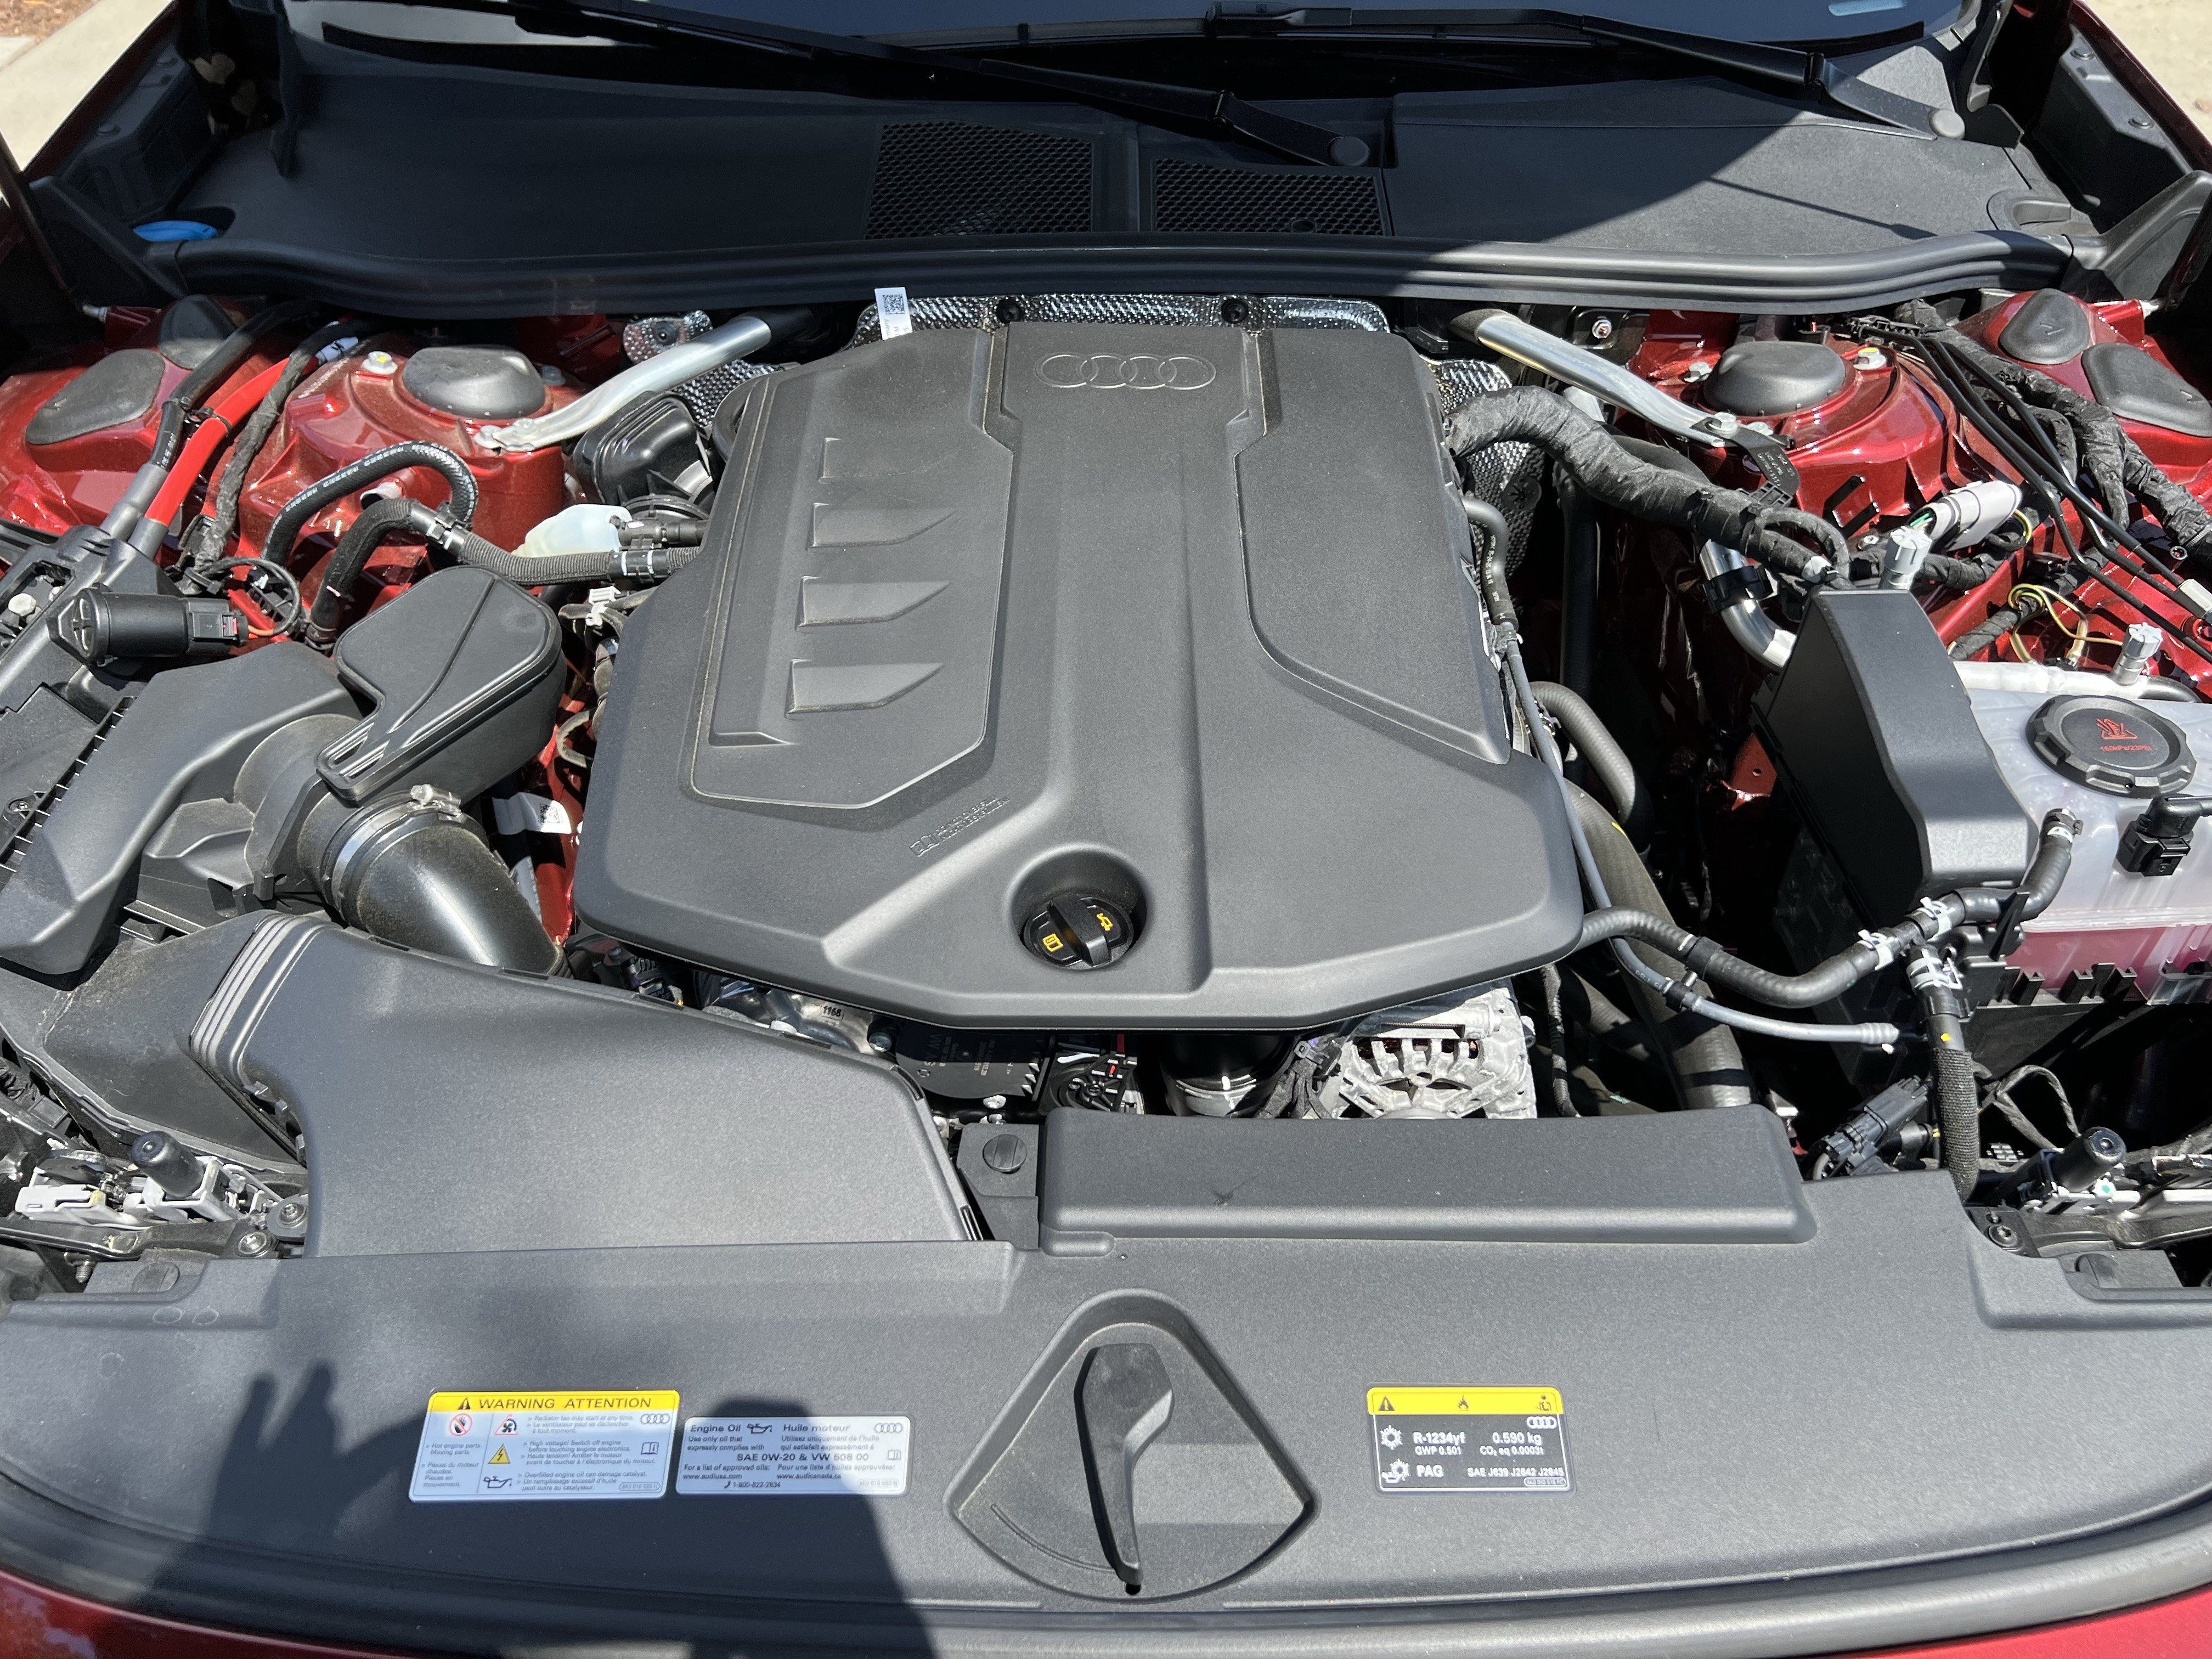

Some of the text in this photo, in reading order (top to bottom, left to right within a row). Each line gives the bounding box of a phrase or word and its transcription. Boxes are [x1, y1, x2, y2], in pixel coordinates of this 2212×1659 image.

[479, 1398, 651, 1409] WARNING ATTENTION
[691, 1424, 724, 1433] Engine
[1413, 1431, 1542, 1446] R-1234yf 0.590 kg
[1415, 1446, 1437, 1455] GWP
[1498, 1447, 1510, 1457] eq
[1511, 1446, 1544, 1455] 0.0003t
[761, 1453, 795, 1462] 0W-20
[1417, 1464, 1444, 1477] PAG
[1467, 1467, 1486, 1477] SAE
[1488, 1467, 1509, 1477] J639
